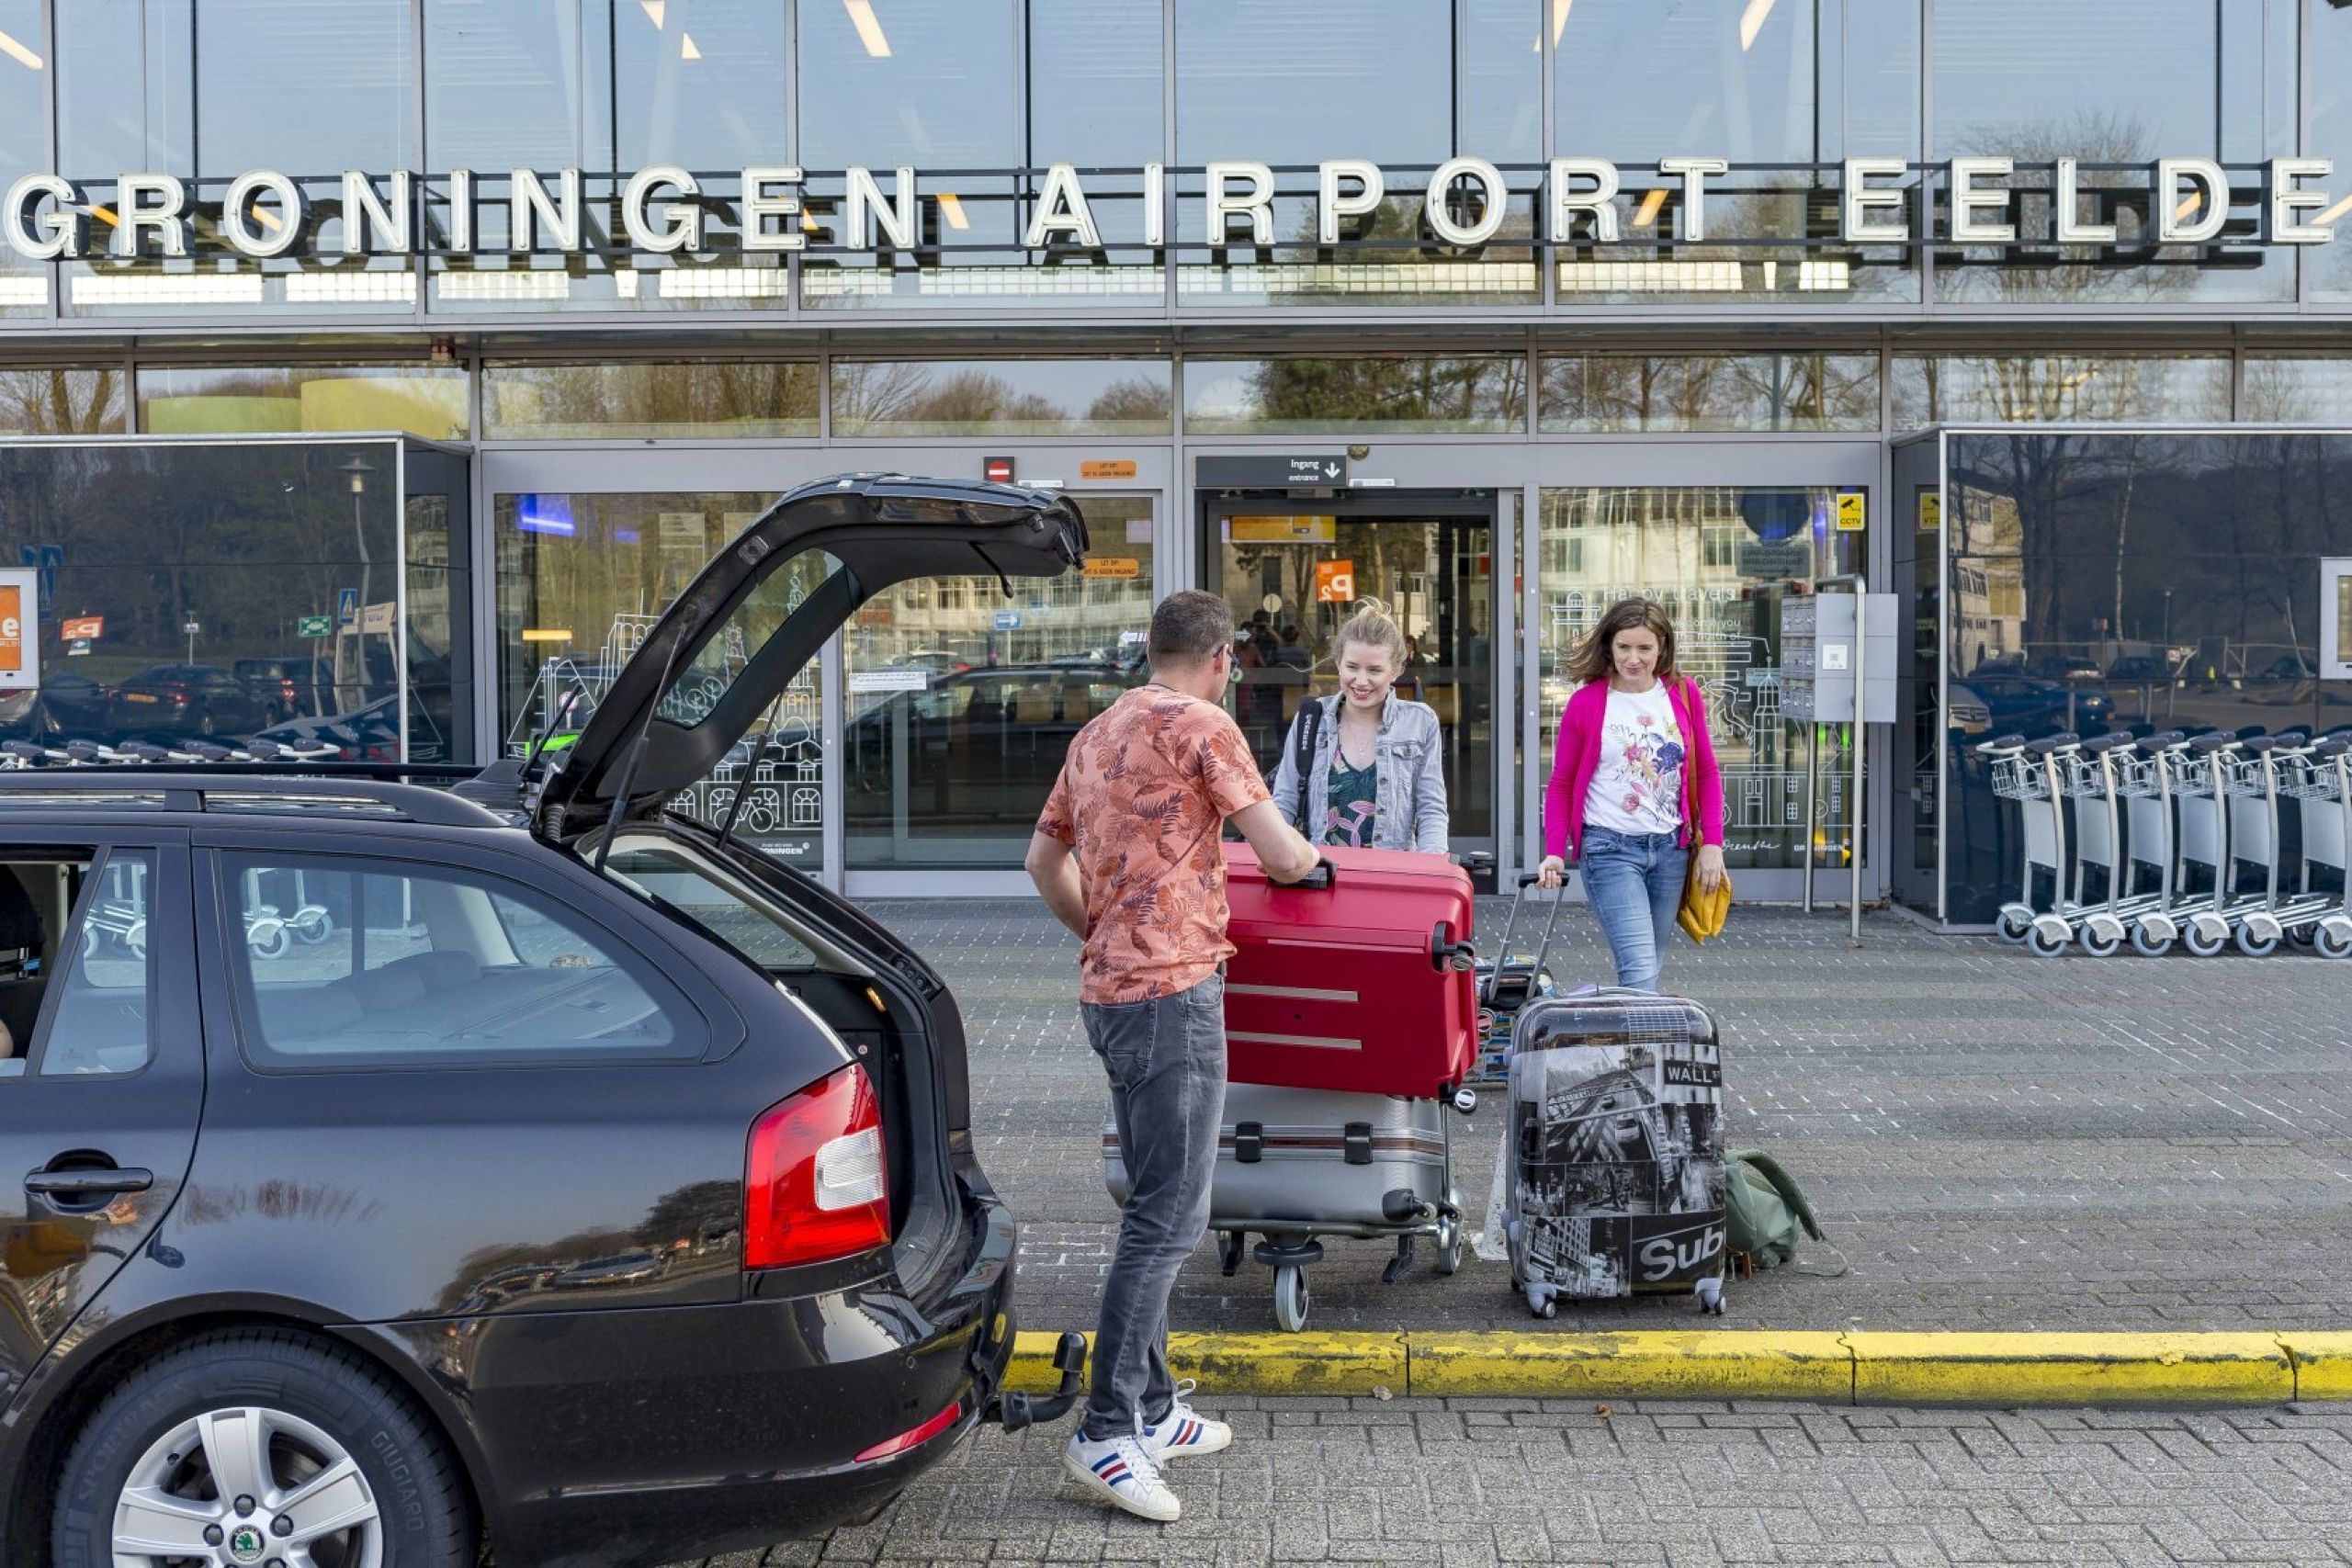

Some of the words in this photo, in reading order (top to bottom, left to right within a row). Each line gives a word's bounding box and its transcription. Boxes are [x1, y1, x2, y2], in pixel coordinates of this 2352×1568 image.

[4, 166, 916, 260] GRONINGEN
[1023, 157, 1728, 249] AIRPORT
[1844, 157, 2335, 243] EELDE
[1291, 459, 1319, 470] Ingang
[1721, 618, 1741, 629] you
[1793, 843, 1844, 852] GRNINGEN
[1668, 1066, 1713, 1083] WALL
[1640, 1226, 1724, 1281] Sub
[369, 1430, 424, 1531] GIUGIARO
